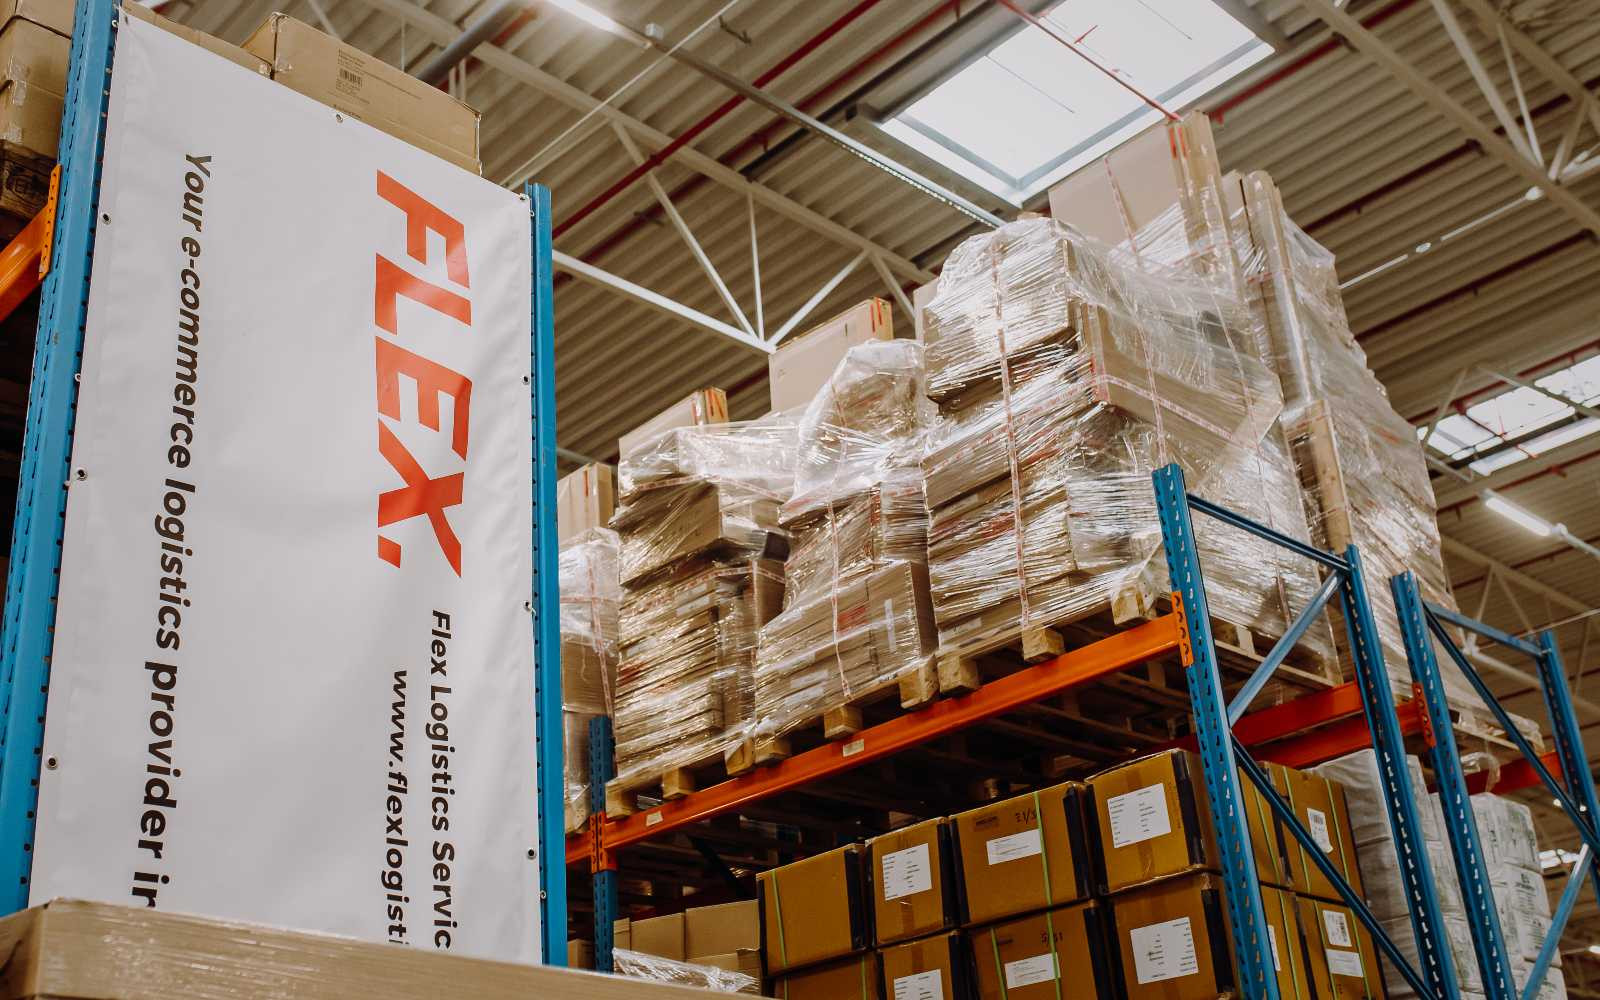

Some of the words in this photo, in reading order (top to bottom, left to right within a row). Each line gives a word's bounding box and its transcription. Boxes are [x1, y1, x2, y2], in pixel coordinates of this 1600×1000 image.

[182, 153, 213, 233] Your
[167, 236, 201, 469] e-commerce
[155, 478, 196, 651] logistics
[430, 609, 452, 677] Flex
[138, 661, 182, 860] provider
[426, 684, 456, 832] Logistics
